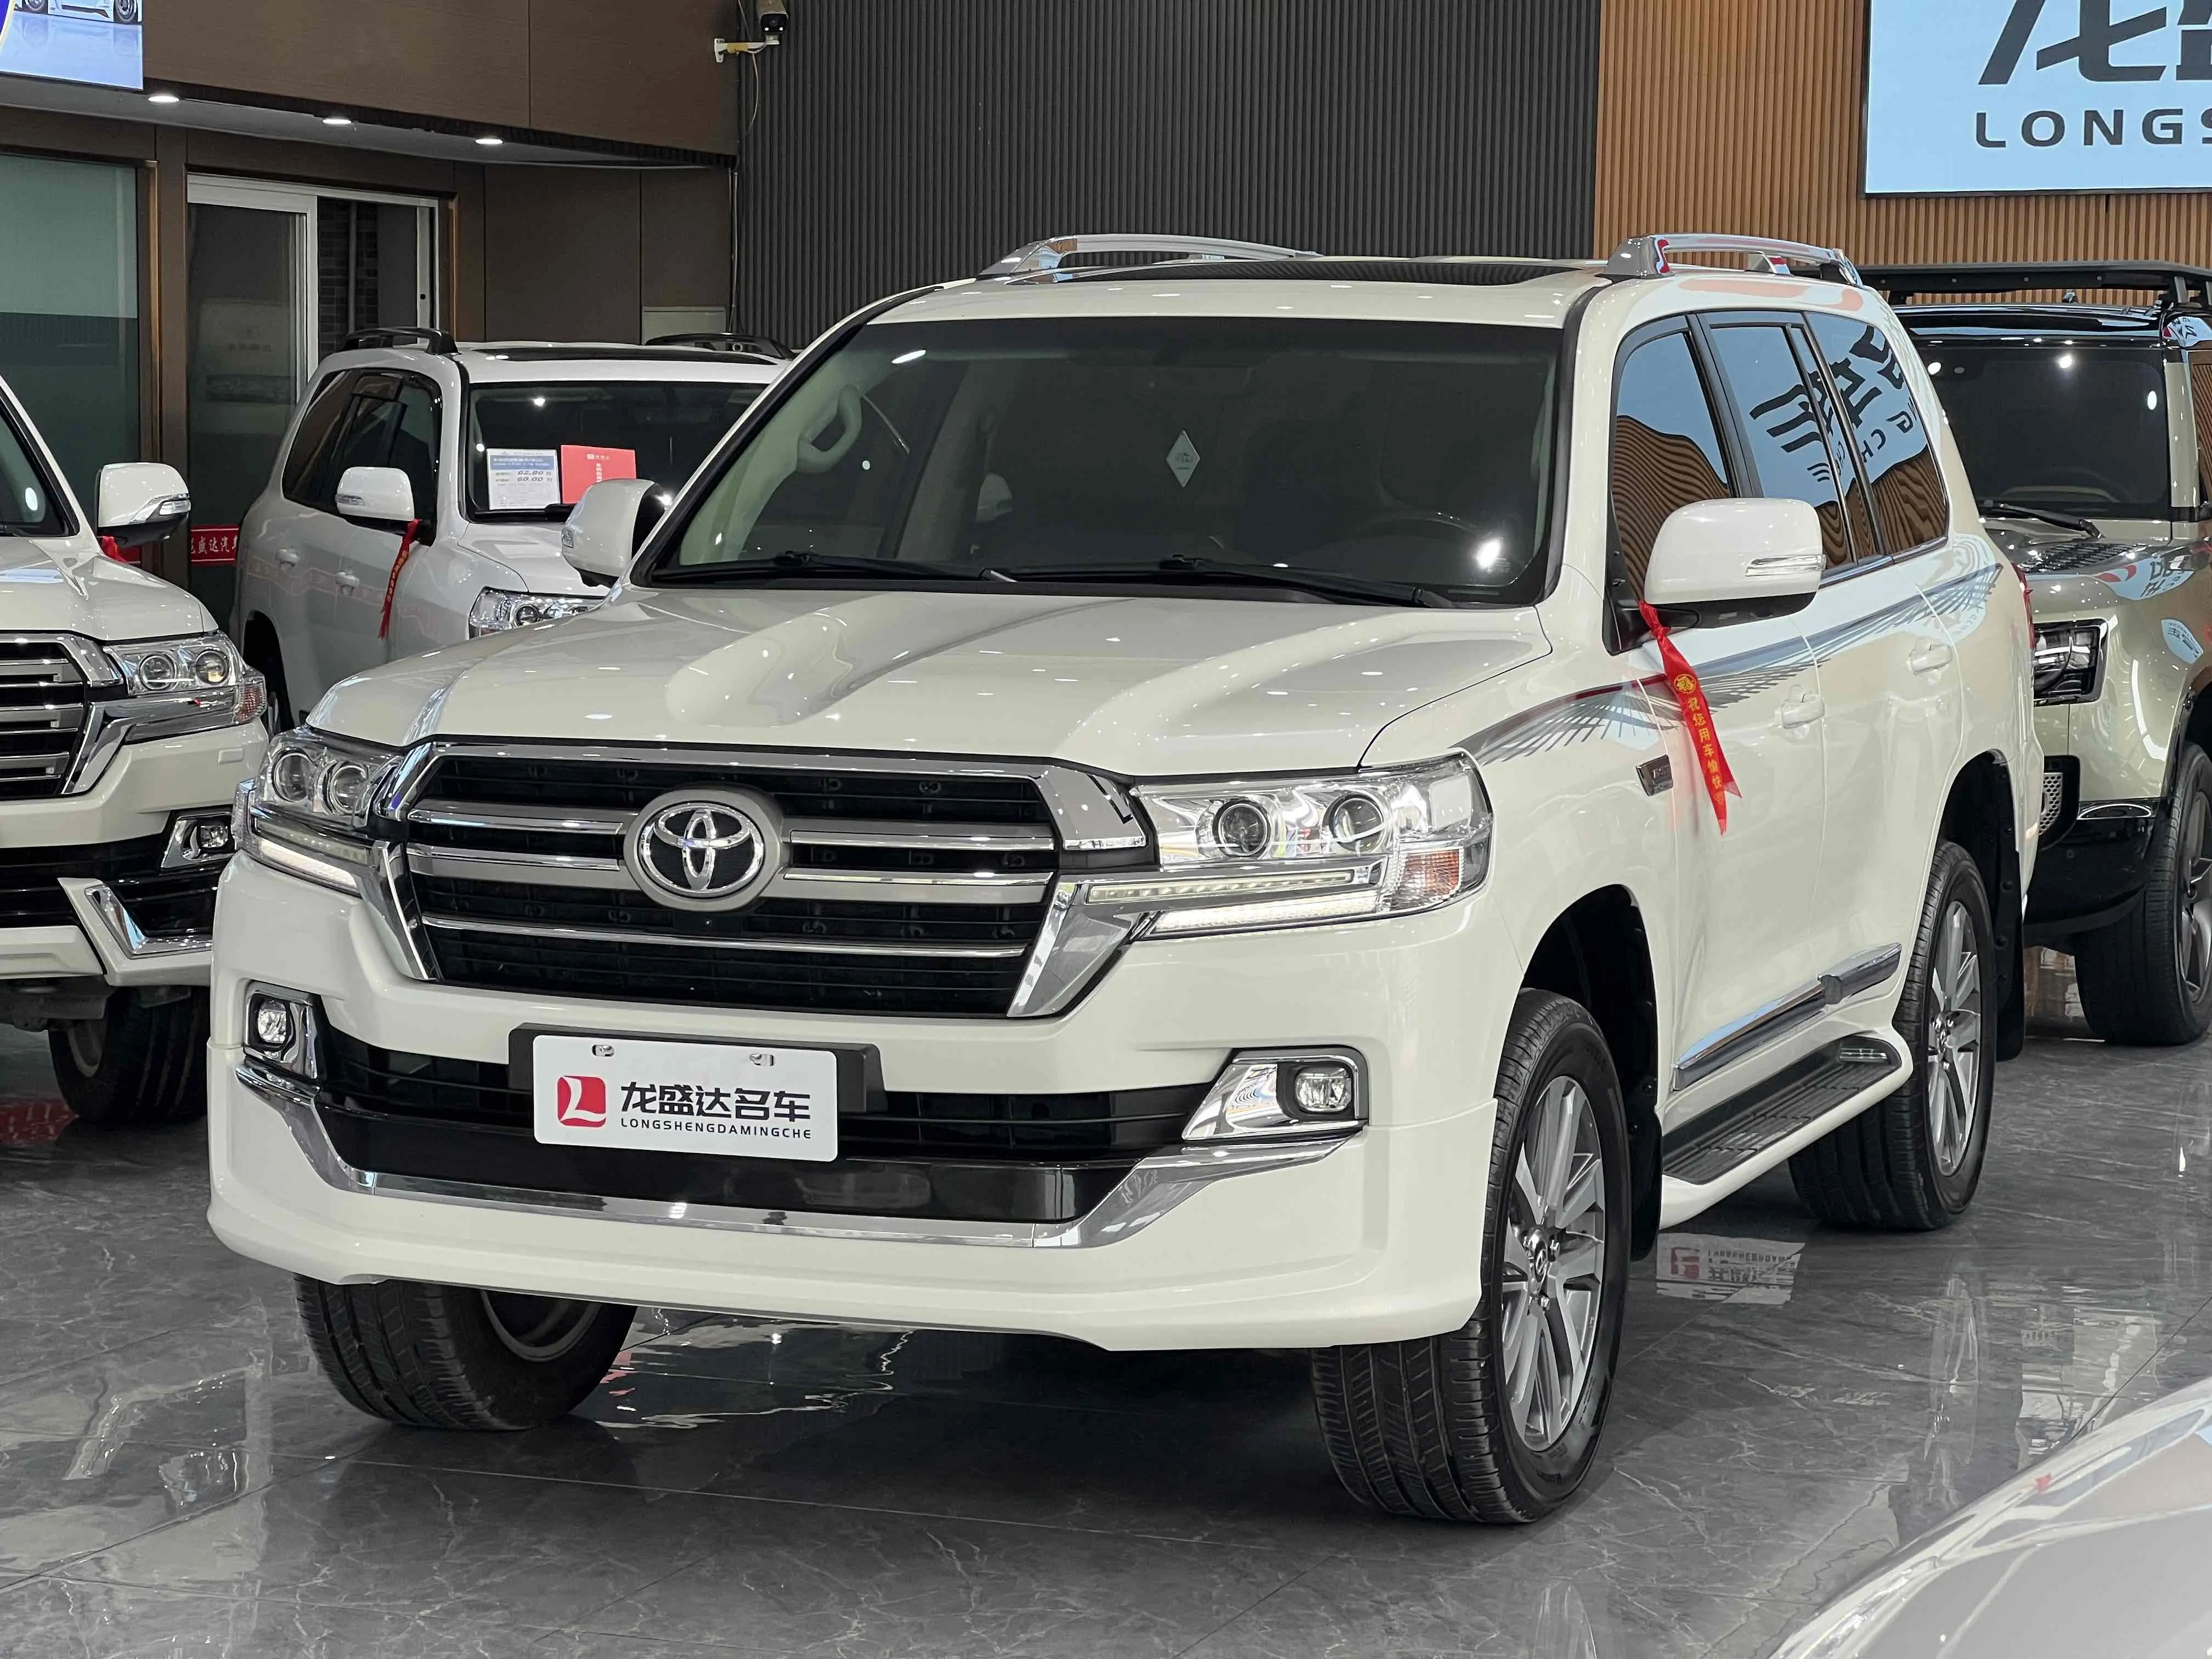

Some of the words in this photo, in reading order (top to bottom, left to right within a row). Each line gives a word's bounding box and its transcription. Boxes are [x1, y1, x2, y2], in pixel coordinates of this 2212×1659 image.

[620, 1081, 811, 1122] 龙盛达名车
[620, 1118, 811, 1139] LONGSHENGDAMINGCHE
